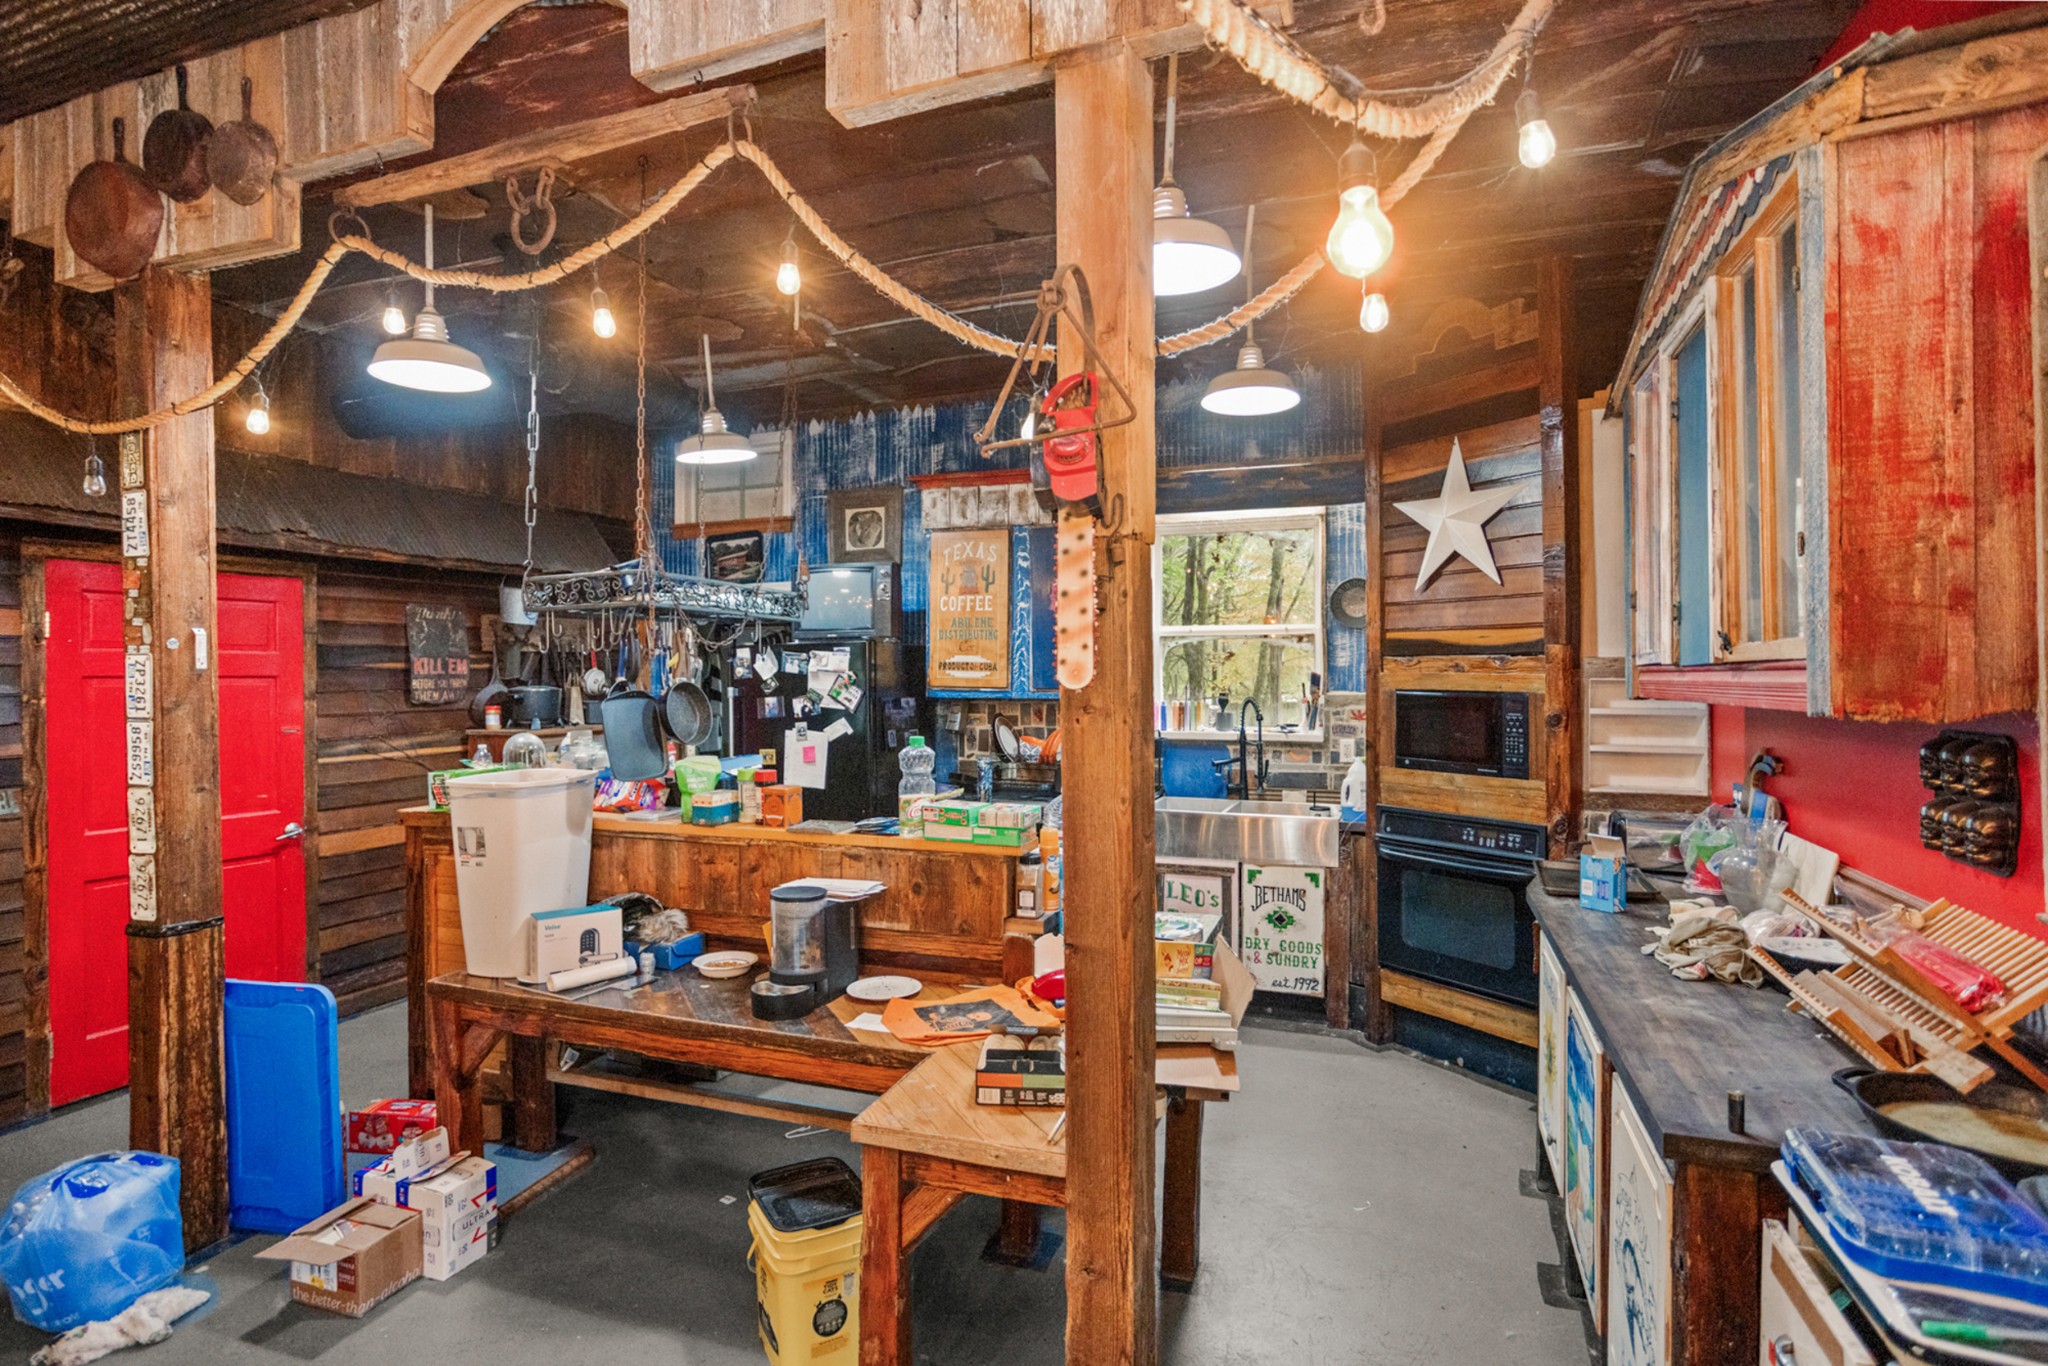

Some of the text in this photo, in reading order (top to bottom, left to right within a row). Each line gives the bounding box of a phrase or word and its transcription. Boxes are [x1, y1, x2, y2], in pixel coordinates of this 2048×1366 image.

[126, 497, 138, 552] ZT4458
[943, 541, 997, 566] TEXAS
[940, 595, 993, 611] COFFEE
[950, 617, 994, 628] ABILENE
[938, 629, 998, 641] DISTRIBUTING
[413, 656, 446, 675] KILL
[979, 661, 998, 672] CUBA
[135, 660, 146, 713] ZP3261
[131, 726, 142, 780] ZS9958
[135, 797, 147, 842] 92671
[136, 864, 148, 911] 92672
[1251, 885, 1306, 912] BETHAMS
[1245, 937, 1322, 955] DRY GOODS
[1253, 951, 1319, 969] & SUNDRY
[1880, 1154, 1959, 1218] KOBALT
[462, 1210, 490, 1230] ULTRA
[292, 1286, 309, 1301] the
